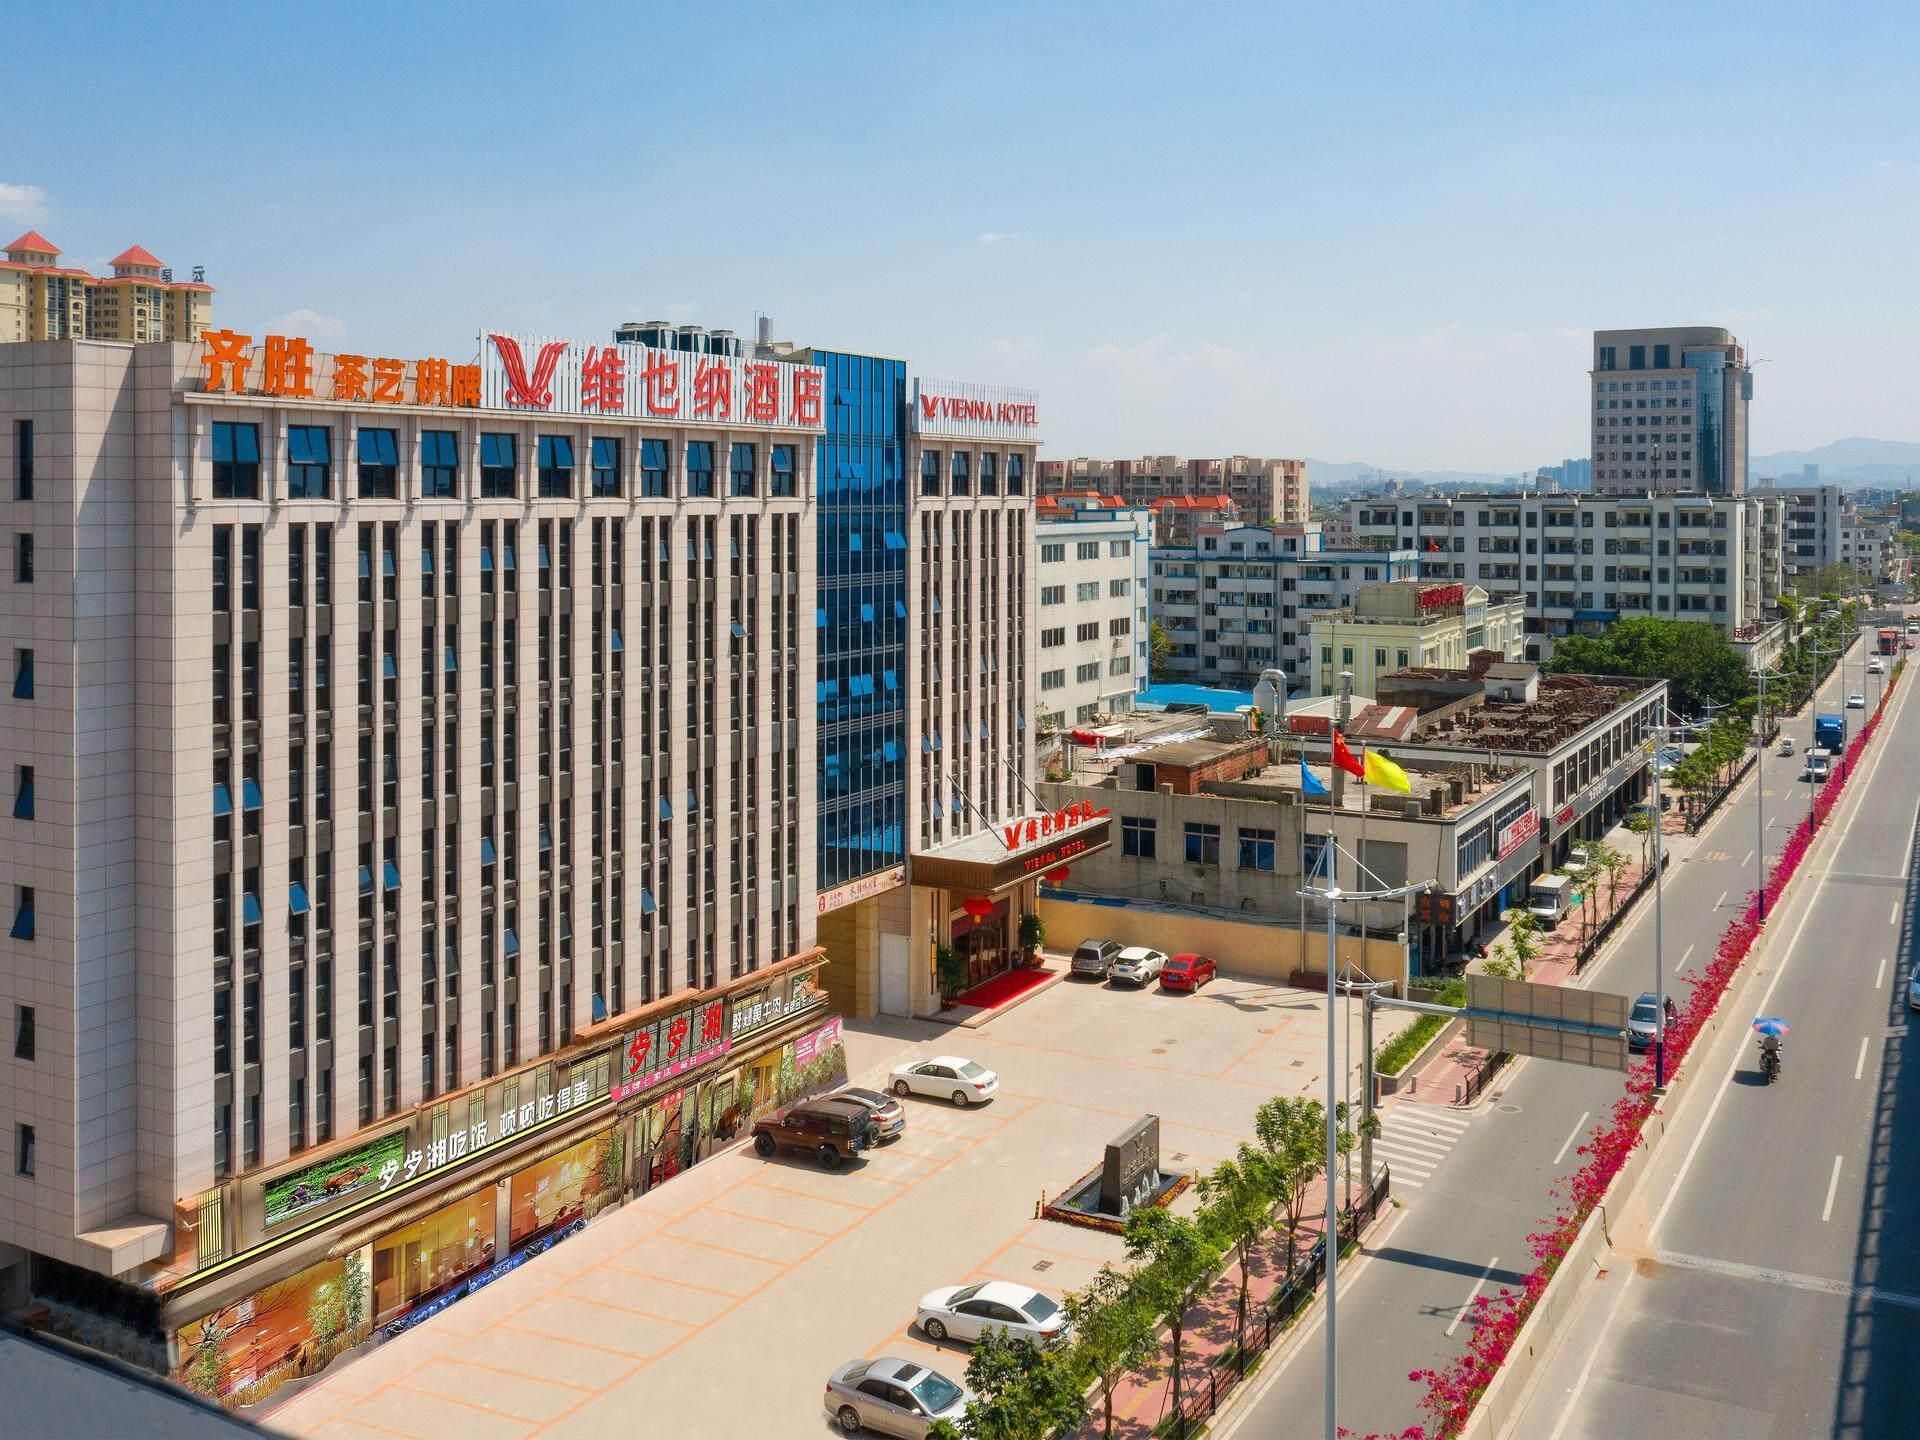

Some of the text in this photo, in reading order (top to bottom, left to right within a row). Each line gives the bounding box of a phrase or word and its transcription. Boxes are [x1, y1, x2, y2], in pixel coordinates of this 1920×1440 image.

[200, 329, 482, 408] 齐胜 茶艺棋牌
[581, 346, 823, 423] 维也纳酒店
[941, 397, 993, 421] VIENNA
[996, 401, 1040, 425] HOTEL
[1024, 839, 1086, 871] VIENNA HOTEL
